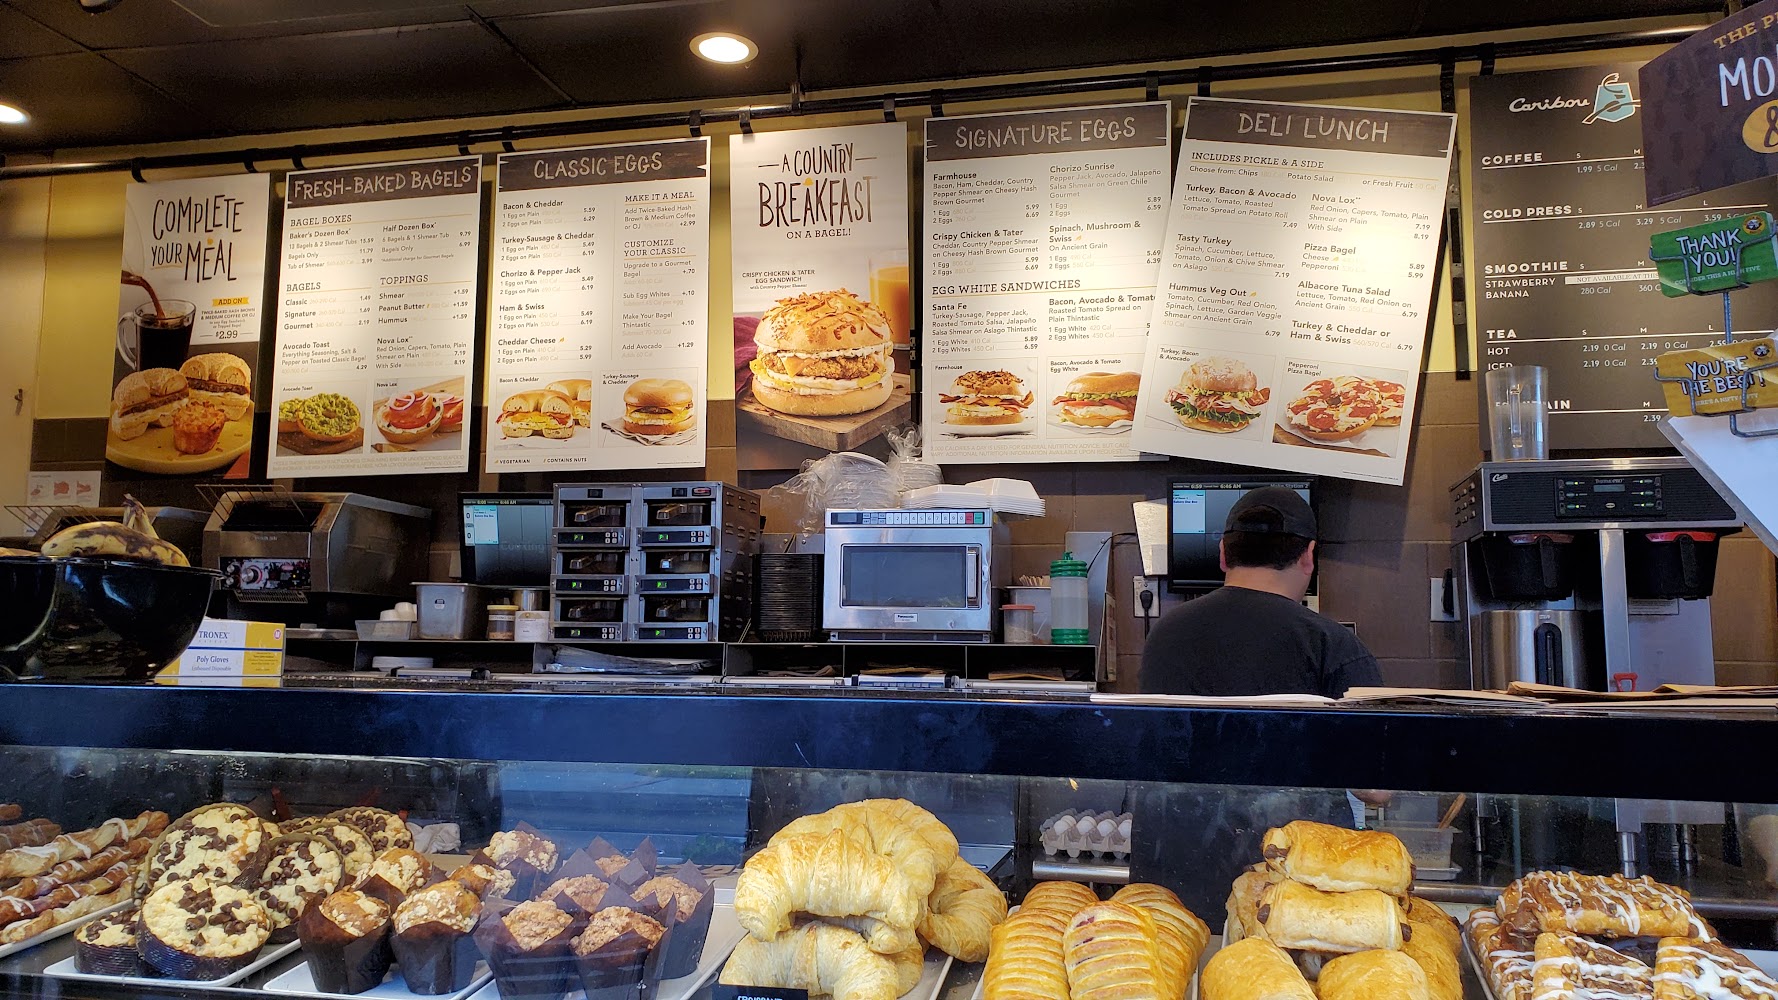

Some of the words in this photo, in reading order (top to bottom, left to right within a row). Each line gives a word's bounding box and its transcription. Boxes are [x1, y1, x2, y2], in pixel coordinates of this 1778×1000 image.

[1714, 22, 1757, 49] THE
[1509, 97, 1590, 113] Caribou
[1237, 112, 1291, 137] DELI
[1304, 116, 1389, 143] LUNCH
[956, 121, 1073, 150] SIGNATURE
[1080, 117, 1136, 142] EGGS
[782, 154, 790, 172] A
[794, 143, 854, 176] COUNTRY
[1192, 152, 1240, 162] INCLUDES
[1243, 156, 1279, 165] PICKLE
[1300, 160, 1324, 168] SIDE
[1482, 153, 1542, 165] COFFEE
[534, 157, 607, 180] CLASSIC
[614, 152, 663, 174] EGGS
[1050, 164, 1082, 173] Chorizo
[1084, 163, 1115, 171] Sunrise
[933, 173, 977, 181] Farmhouse
[1218, 167, 1236, 175] from:
[1238, 168, 1258, 177] Chips
[294, 173, 406, 200] FRESH-BAKED
[411, 166, 471, 190] BAGELS
[625, 194, 649, 203] MAKE
[671, 191, 695, 199] MEAL
[1186, 184, 1216, 194] Turkey,
[1219, 186, 1245, 195] Bacon
[1258, 189, 1297, 199] Avocado
[533, 200, 563, 208] Cheddar
[758, 176, 878, 227] BREAKFAST
[153, 195, 244, 240] COMPLETE
[1483, 209, 1521, 219] COLD
[1527, 205, 1572, 217] PRESS
[290, 217, 320, 227] BAGEL
[322, 215, 352, 224] BOXES
[1606, 220, 1620, 228] Cal
[1667, 216, 1682, 224] Cal
[1704, 214, 1722, 222] 3.59
[382, 224, 397, 232] Half
[1049, 225, 1084, 234] Spinach,
[1086, 221, 1131, 230] Mushroom
[289, 231, 313, 239] Baker's
[314, 229, 335, 237] Dozen
[501, 234, 555, 244] Turkey-Sausage
[564, 232, 594, 240] Cheddar
[786, 230, 802, 239] ON
[805, 230, 812, 238] A
[815, 228, 851, 238] BAGEL!
[933, 233, 958, 241] Crispy
[960, 231, 991, 239] Chicken
[1049, 235, 1072, 243] Swiss
[624, 239, 674, 248] CUSTOMIZE
[1178, 234, 1200, 244] Tasty
[1202, 236, 1232, 246] Turkey
[1675, 228, 1742, 255] THANK
[624, 249, 648, 257] YOUR
[650, 247, 686, 255] CLASSIC
[1304, 243, 1328, 252] Pizza
[1330, 246, 1356, 255] Bagel
[151, 242, 183, 266] YOUR
[184, 239, 237, 283] MEAL
[1689, 247, 1738, 273] YOU!
[500, 270, 527, 278] Chorizo
[537, 269, 563, 277] Pepper
[565, 267, 581, 275] Jack
[1485, 261, 1568, 274] SMOOTHIE
[380, 275, 429, 285] TOPPINGS
[1485, 278, 1556, 288] STRAWBERRY
[286, 282, 321, 292] BAGELS
[932, 286, 955, 295] EGG
[959, 284, 997, 293] WHITE
[1000, 280, 1081, 291] SANDWICHES
[1169, 283, 1207, 293] Hummus
[1210, 286, 1226, 296] Veg
[1229, 288, 1247, 296] Out
[1298, 281, 1339, 291] Albacore
[1341, 285, 1363, 294] Tuna
[1365, 287, 1391, 296] Salad
[1581, 287, 1594, 295] 280
[379, 292, 404, 300] Shmear
[1485, 290, 1529, 299] BANANA
[285, 298, 307, 306] Classic
[1049, 298, 1076, 306] Bacon,
[1078, 296, 1115, 304] Avocado
[378, 304, 401, 312] Peanut
[525, 303, 545, 311] Swiss
[284, 310, 316, 319] Signature
[284, 322, 313, 330] Gourmet
[1292, 320, 1323, 331] Turkey
[1336, 325, 1377, 336] Cheddar
[216, 330, 238, 339] $2.99
[1290, 331, 1311, 340] Ham
[1325, 334, 1351, 344] Swiss
[1486, 330, 1517, 339] TEA
[283, 342, 311, 350] Avocado
[498, 338, 528, 346] Cheddar
[1685, 356, 1749, 380] YOU'RE
[199, 631, 228, 639] TRONEX
[196, 656, 209, 664] Poly
[210, 655, 229, 663] Gloves
